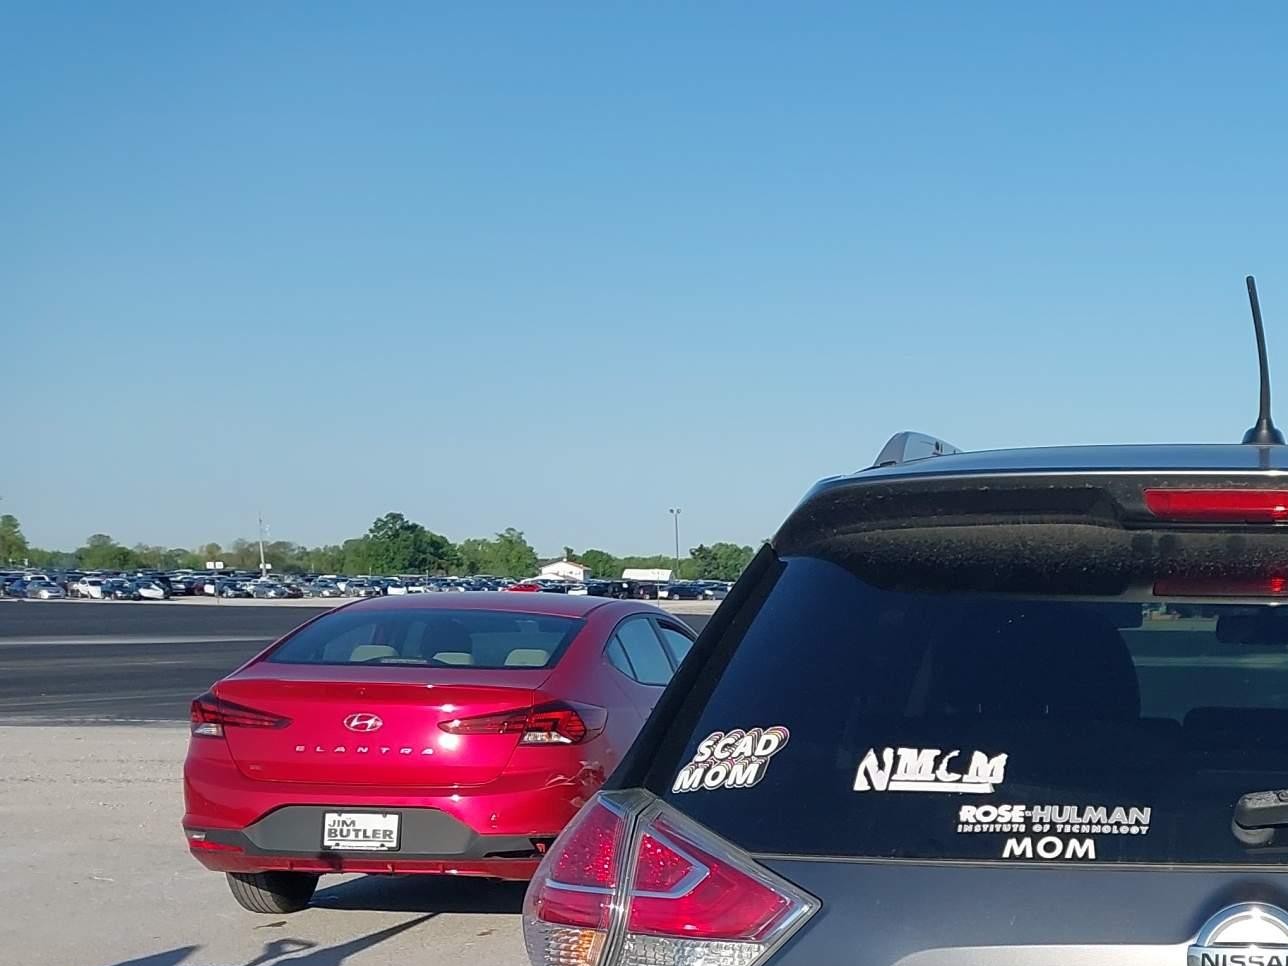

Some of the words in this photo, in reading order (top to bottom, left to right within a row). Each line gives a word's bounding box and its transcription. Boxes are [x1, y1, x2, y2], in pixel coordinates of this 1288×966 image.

[295, 745, 434, 755] ELANTRA
[692, 734, 781, 763] SCAD
[672, 763, 759, 791] MOM
[959, 804, 1151, 824] ROSE-HULMAN
[328, 819, 356, 828] JIM
[957, 824, 1026, 833] INSTITUTE
[1032, 824, 1050, 833] OF
[1056, 824, 1149, 835] TECHNOLOGY
[327, 828, 394, 840] BUTLER
[1002, 836, 1096, 860] MOM
